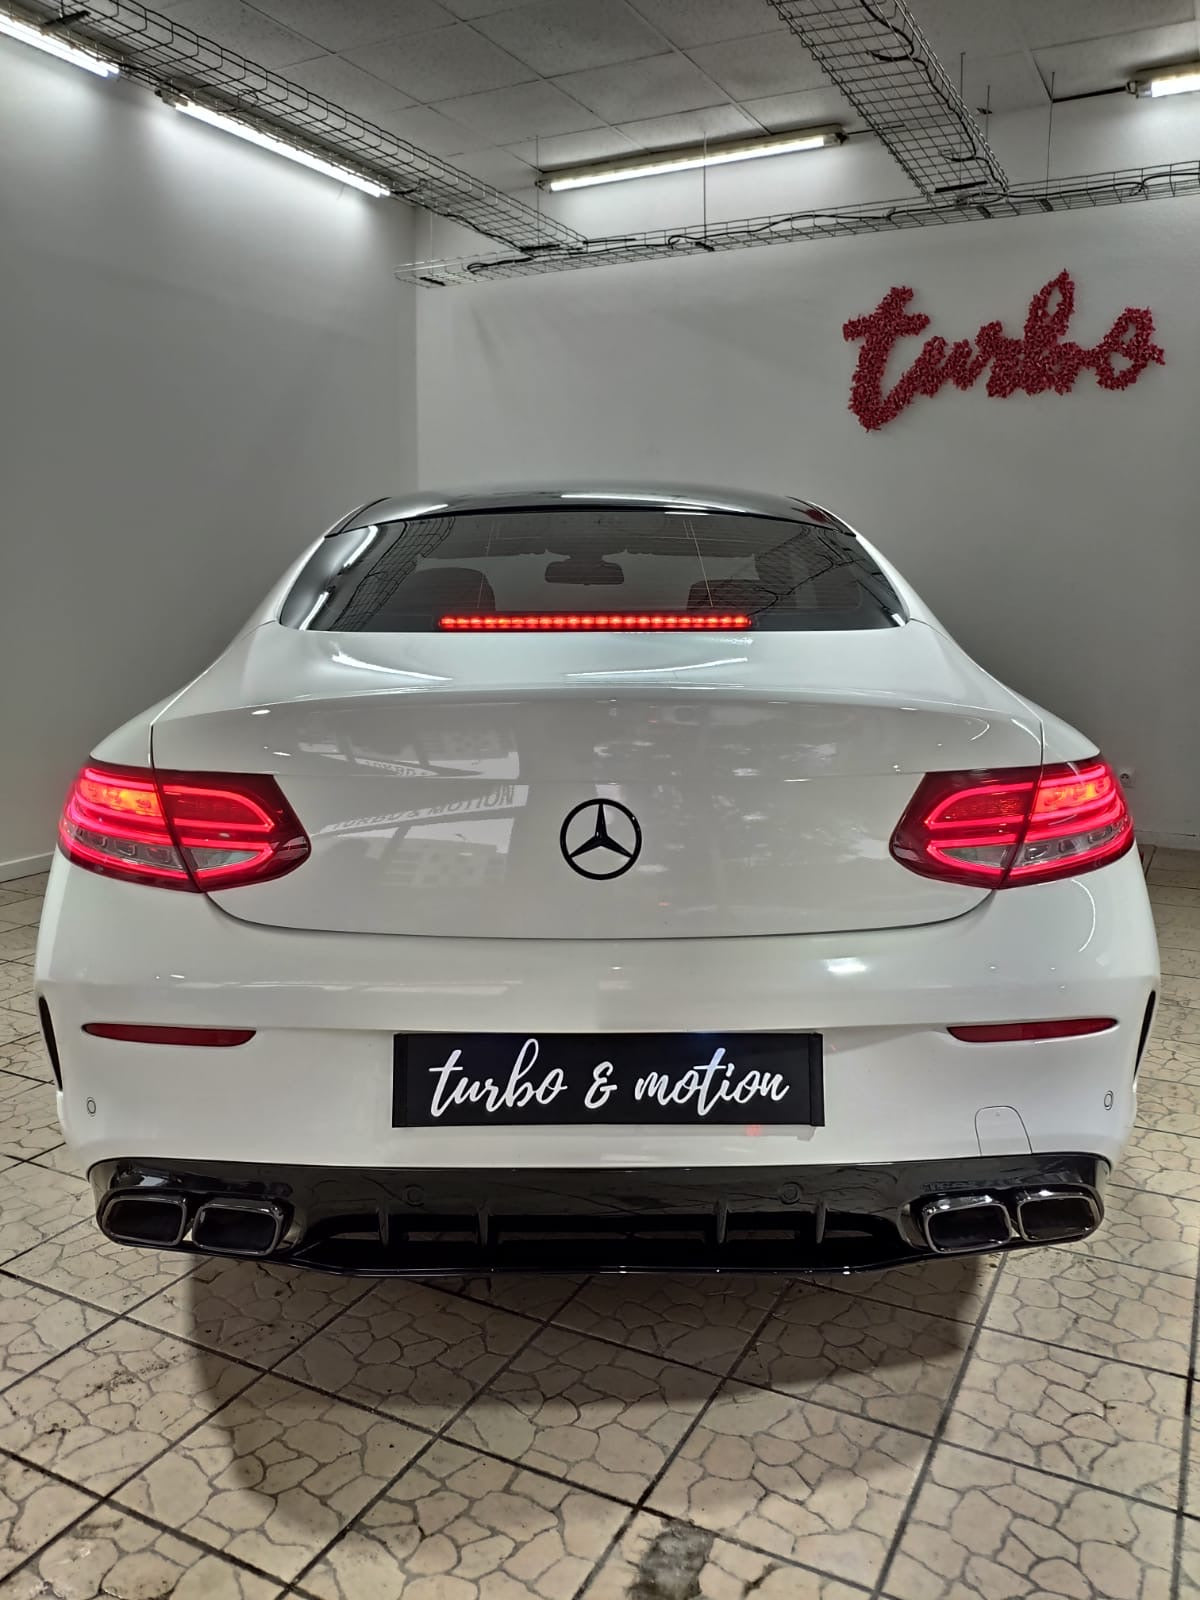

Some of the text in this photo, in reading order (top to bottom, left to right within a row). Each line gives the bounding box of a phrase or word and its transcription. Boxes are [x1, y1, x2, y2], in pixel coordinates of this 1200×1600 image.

[842, 269, 1166, 431] turbo
[428, 1038, 790, 1118] turbo & motion
